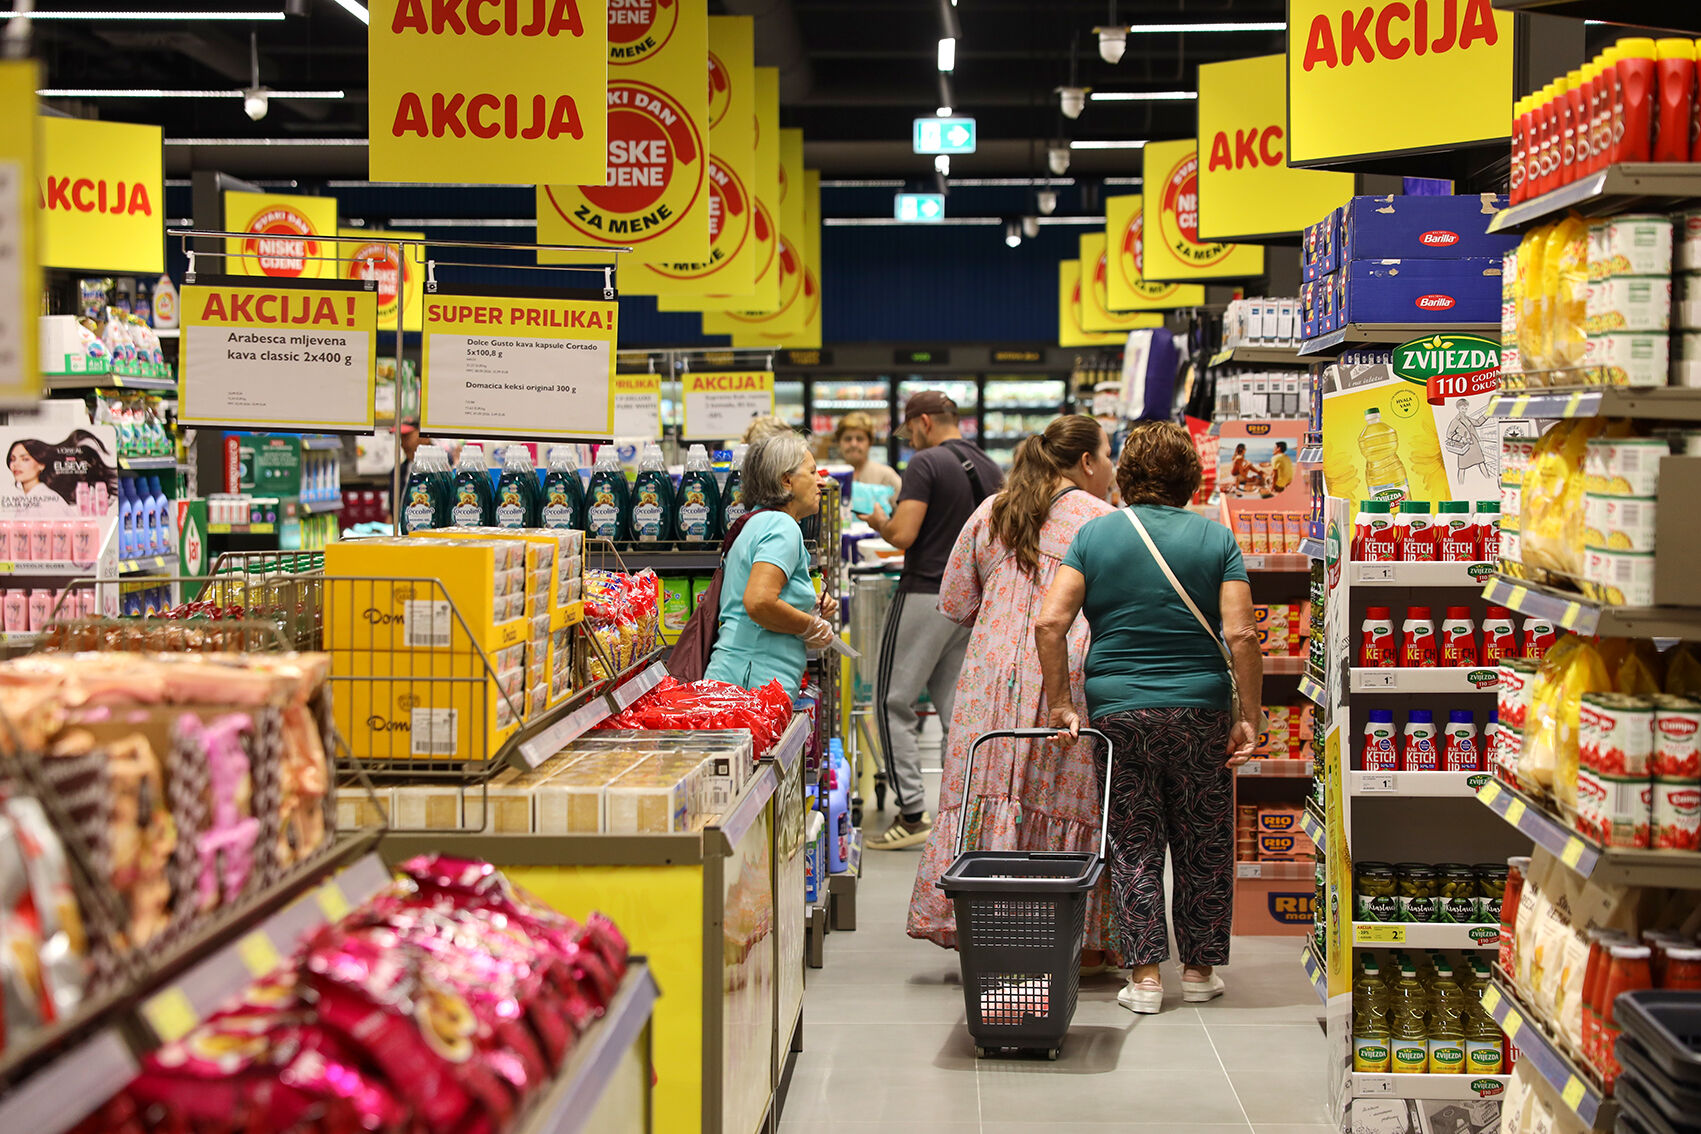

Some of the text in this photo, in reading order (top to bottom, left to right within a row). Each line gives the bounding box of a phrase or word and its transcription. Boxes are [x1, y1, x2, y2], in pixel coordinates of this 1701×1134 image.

[391, 0, 584, 37] AKCIJA
[608, 10, 650, 25] JENE
[1302, 0, 1498, 72] AKCIJA
[611, 36, 657, 59] MENE
[392, 92, 584, 140] AKCIJA
[634, 91, 677, 127] DAN
[608, 140, 667, 164] SKE
[1208, 125, 1284, 173] AKC
[606, 167, 664, 187] JENE
[709, 163, 729, 187] AN
[38, 176, 152, 217] KCIJA
[574, 203, 673, 234] ZA MENE
[1424, 234, 1457, 244] Barilla
[259, 238, 305, 256] NISKE
[201, 293, 356, 327] AKCIJA!
[1420, 297, 1454, 308] Barilla
[428, 304, 613, 331] SUPER PRILIKA!
[228, 332, 346, 347] Arabesca mljevena
[467, 338, 598, 351] Dolce Gusto kava kapsule Cortado
[227, 350, 352, 366] kava classic 2x400 g
[467, 349, 503, 359] 5x100,8 g
[1402, 350, 1499, 375] ZVIJEZDA
[465, 381, 577, 394] Domacica keksi original 300 g
[692, 375, 765, 391] AKCIJA!
[1436, 376, 1468, 395] 110
[1472, 380, 1500, 393] OKUS
[189, 539, 199, 562] Jar
[1365, 542, 1394, 554] KETCH
[1404, 542, 1433, 554] KETCH
[1443, 542, 1472, 554] KETCH
[1469, 674, 1496, 684] ZVIJEZDA
[1366, 752, 1396, 763] KETCH
[1406, 752, 1436, 763] KETCH
[1448, 752, 1476, 763] KETCH
[1264, 816, 1292, 825] RIO
[1264, 838, 1292, 847] RIO
[1392, 931, 1398, 940] 2
[1360, 1050, 1387, 1060] ZVIJEZDA
[1398, 1051, 1424, 1061] ZVIJEZDA
[1436, 1051, 1462, 1061] ZVIJEZDA
[1473, 1052, 1499, 1062] ZVIJEZDA
